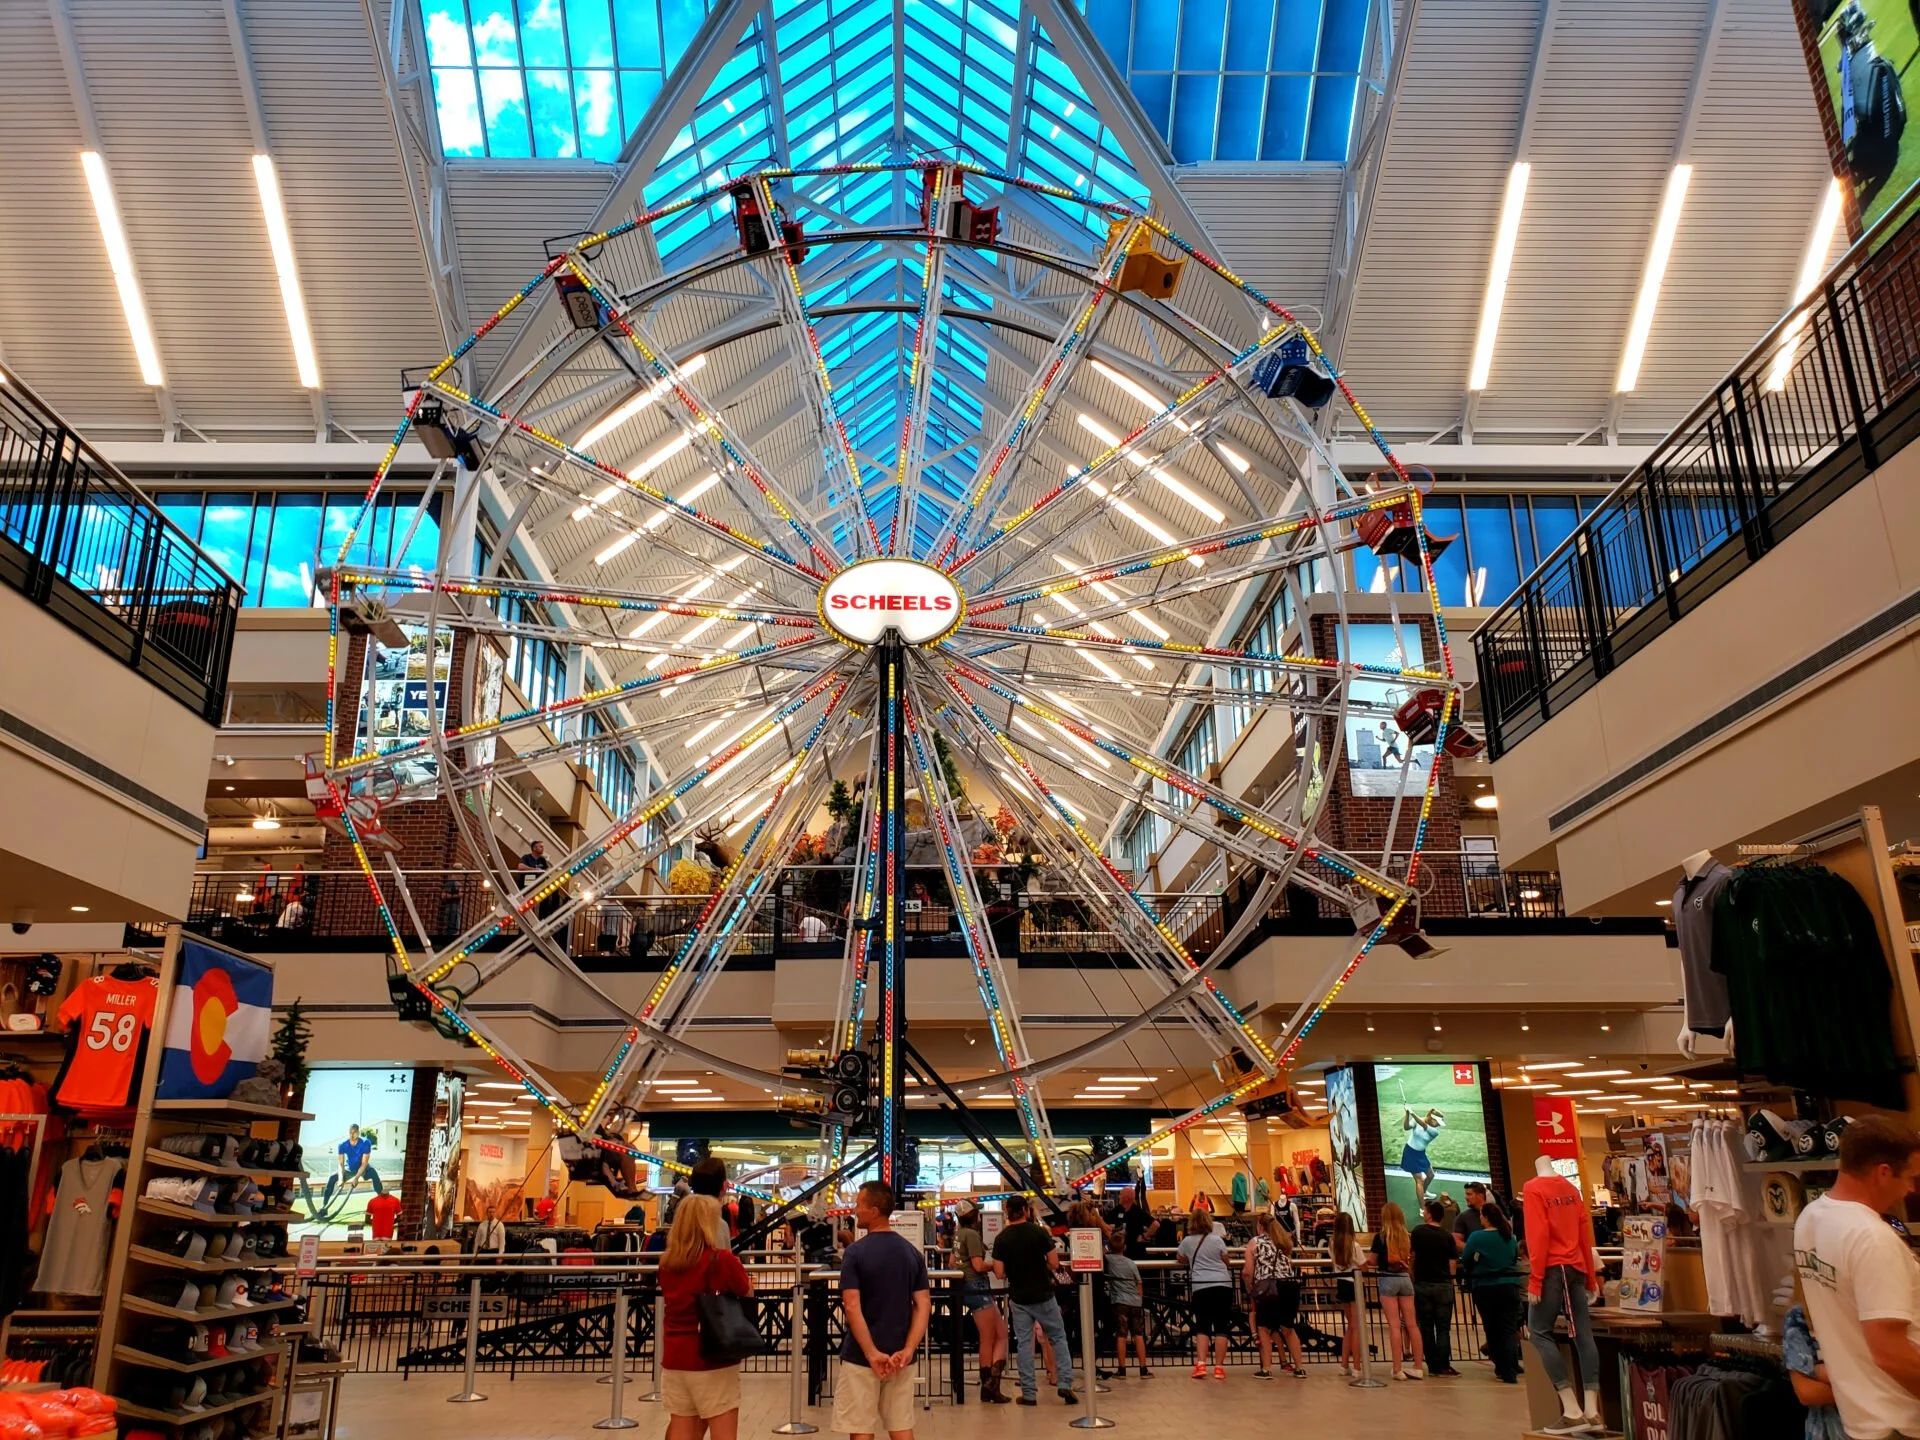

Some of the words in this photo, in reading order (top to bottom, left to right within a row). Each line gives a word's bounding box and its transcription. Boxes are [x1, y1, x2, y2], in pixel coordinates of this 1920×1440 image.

[831, 594, 952, 611] SCHEELS
[106, 993, 137, 1006] MILLER
[86, 1011, 136, 1052] 58
